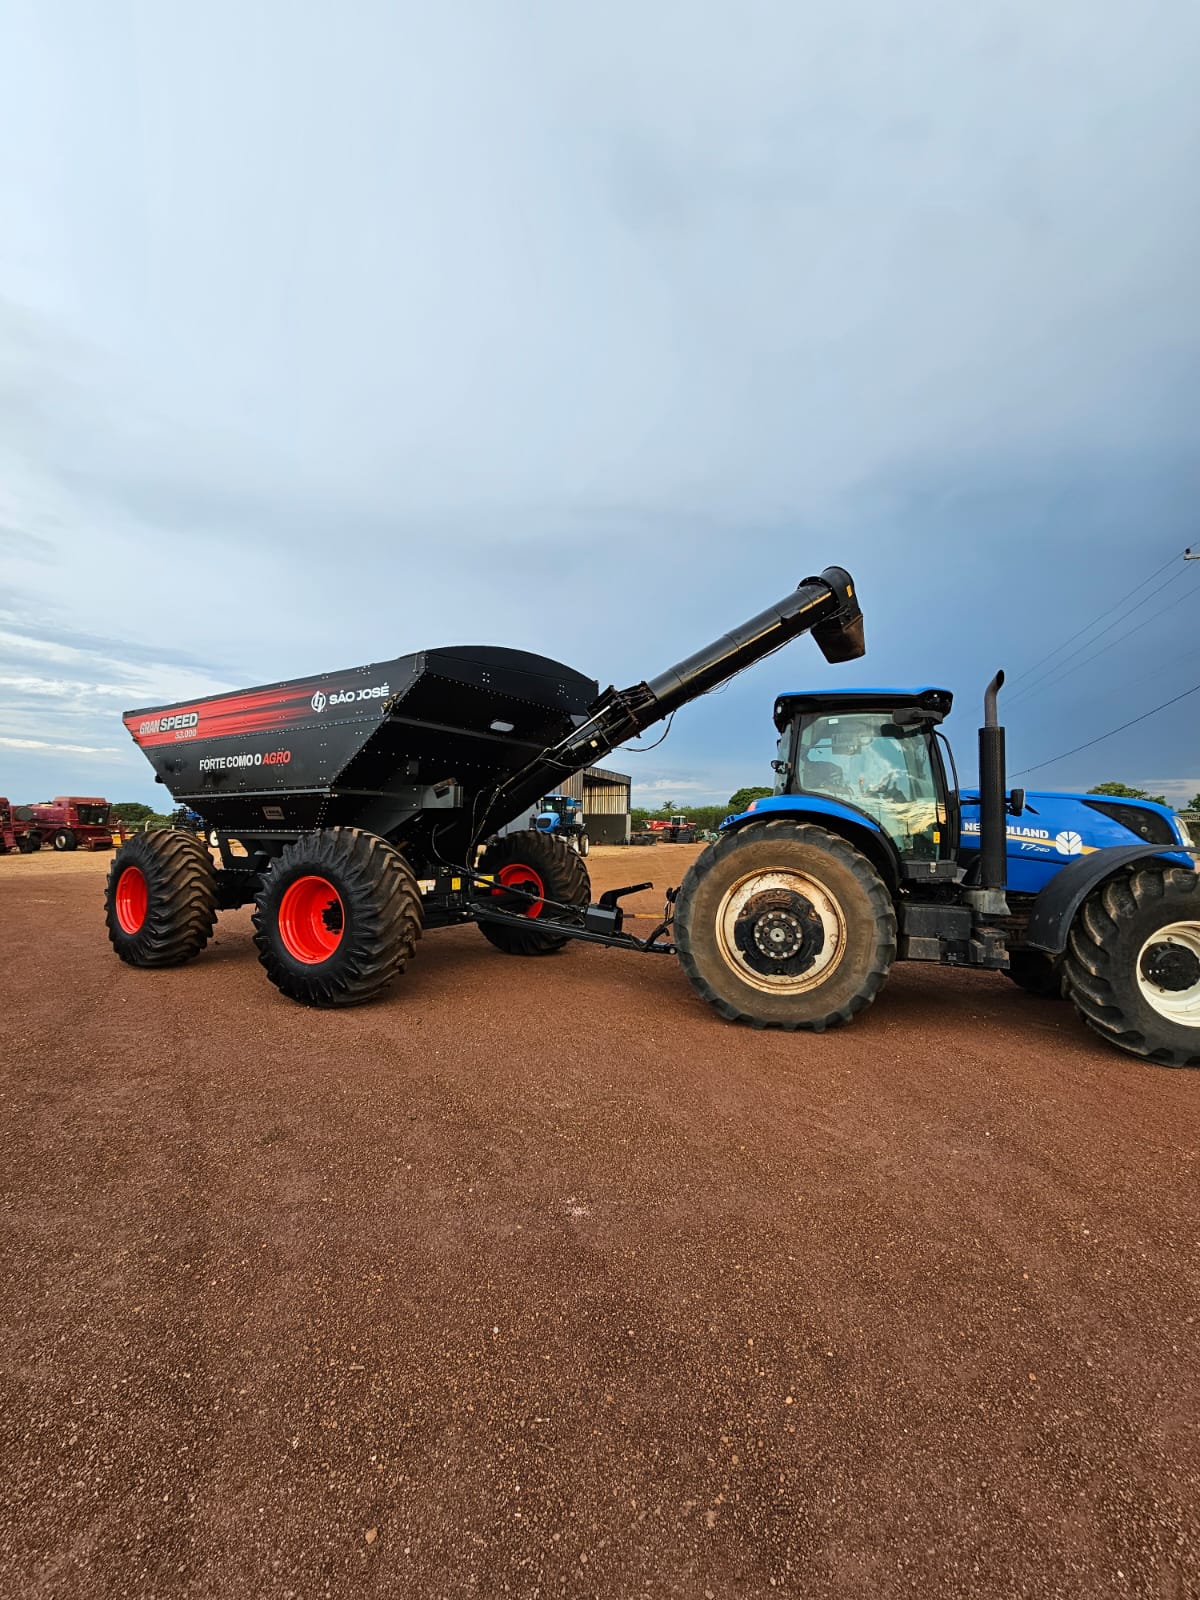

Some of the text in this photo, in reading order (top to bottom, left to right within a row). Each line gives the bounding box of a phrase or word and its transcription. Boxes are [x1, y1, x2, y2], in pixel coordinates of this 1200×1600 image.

[329, 682, 390, 705] SÃO JOSÉ
[199, 750, 291, 771] FORTE COMO O AGRO
[964, 822, 981, 832] NE
